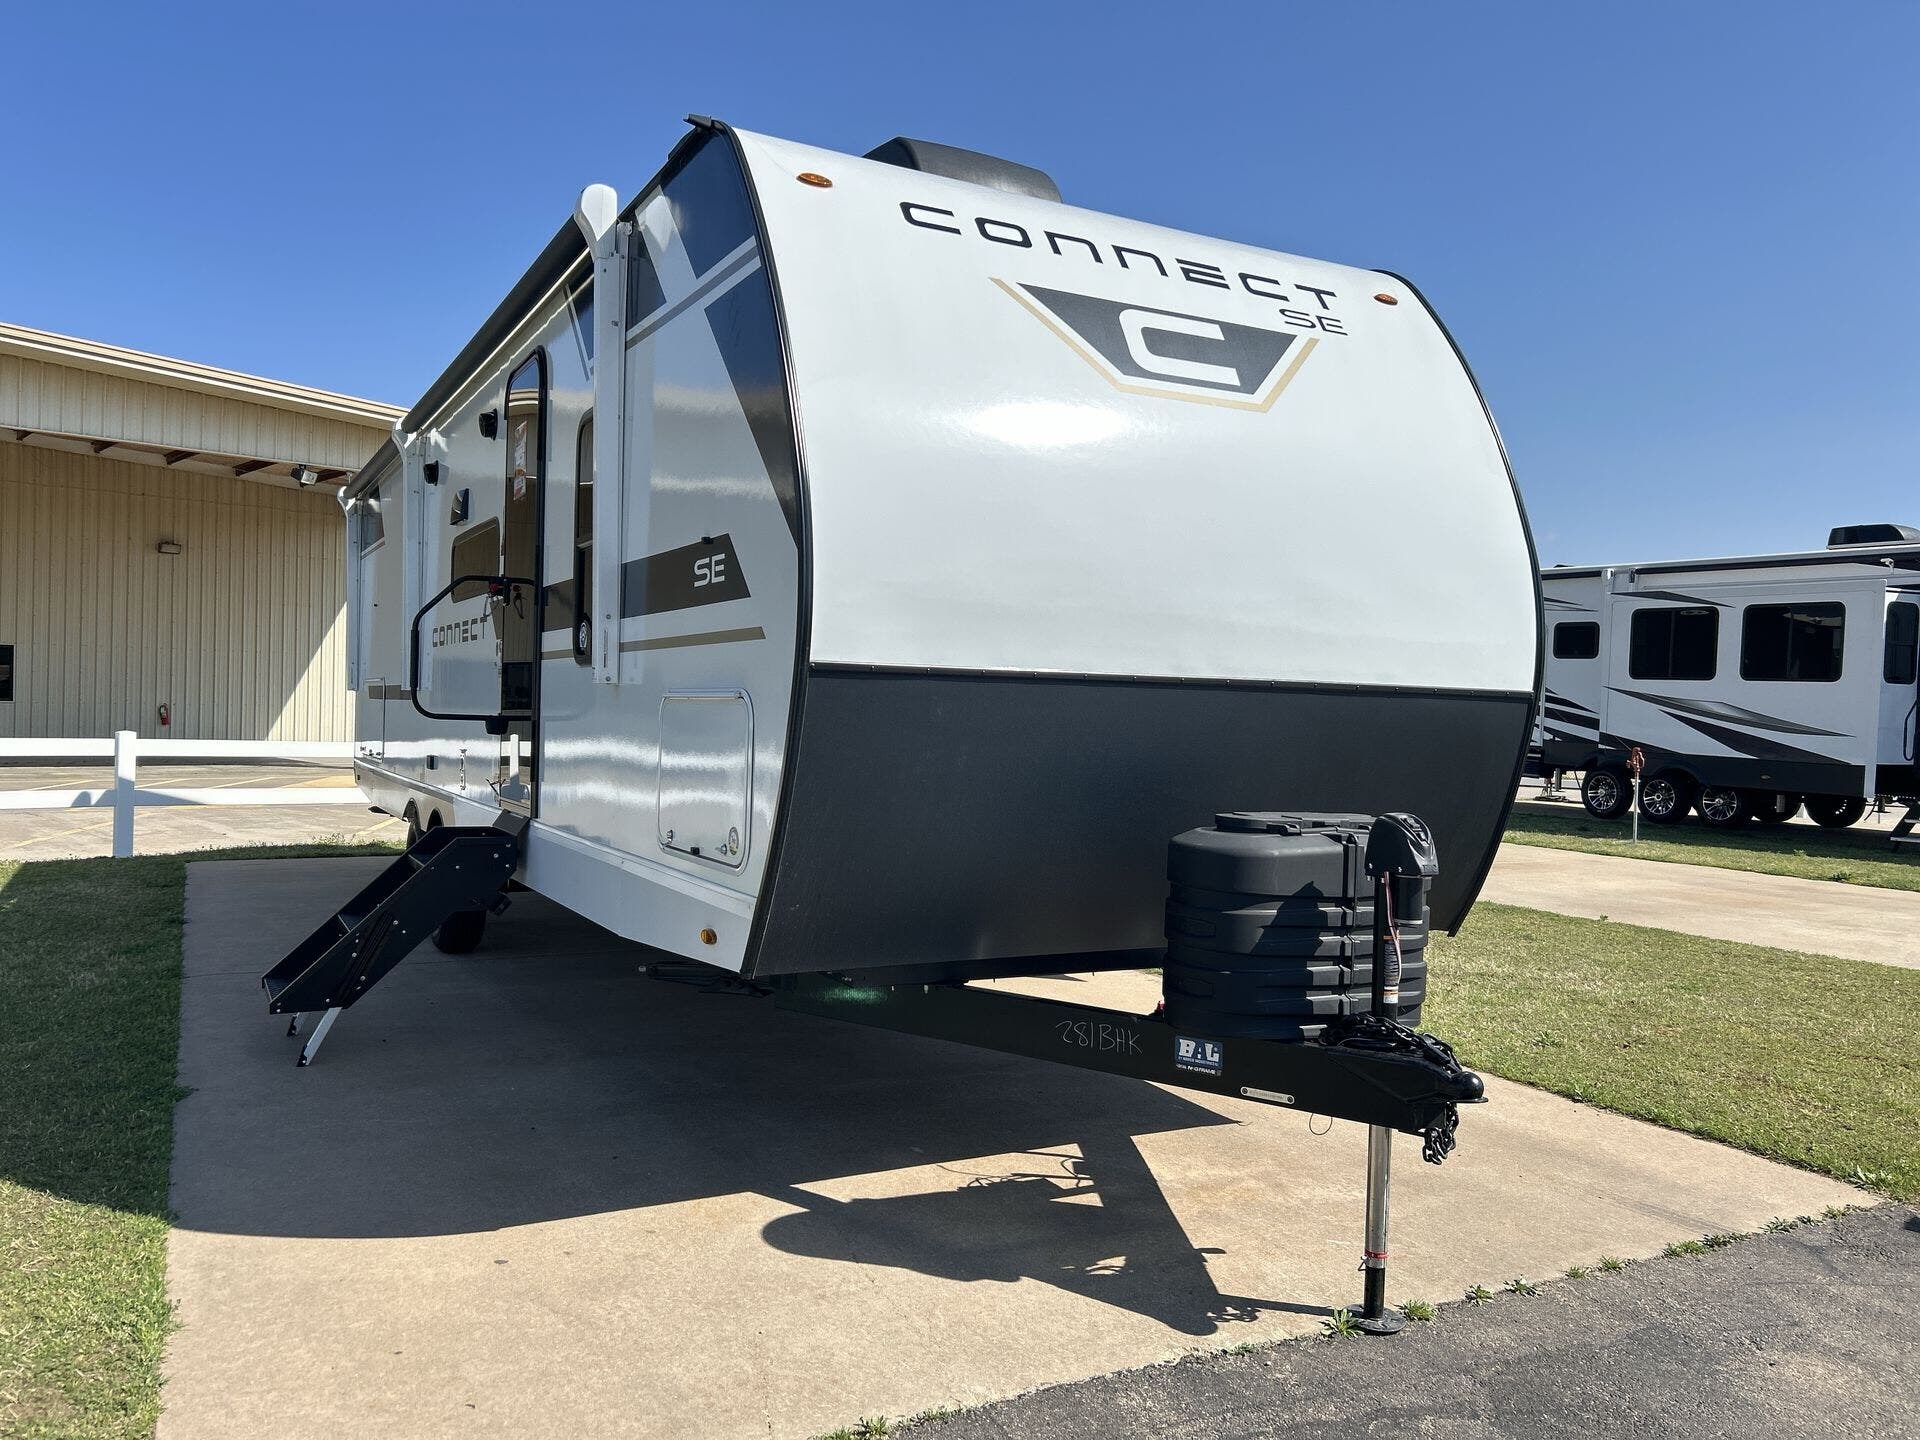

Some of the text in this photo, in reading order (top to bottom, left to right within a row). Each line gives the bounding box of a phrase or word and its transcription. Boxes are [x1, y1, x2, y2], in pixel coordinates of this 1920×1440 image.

[899, 201, 1336, 310] CONNECT
[1279, 308, 1348, 336] SE
[693, 553, 725, 587] SE
[432, 616, 488, 648] CONNECT
[1178, 1038, 1220, 1062] BAL
